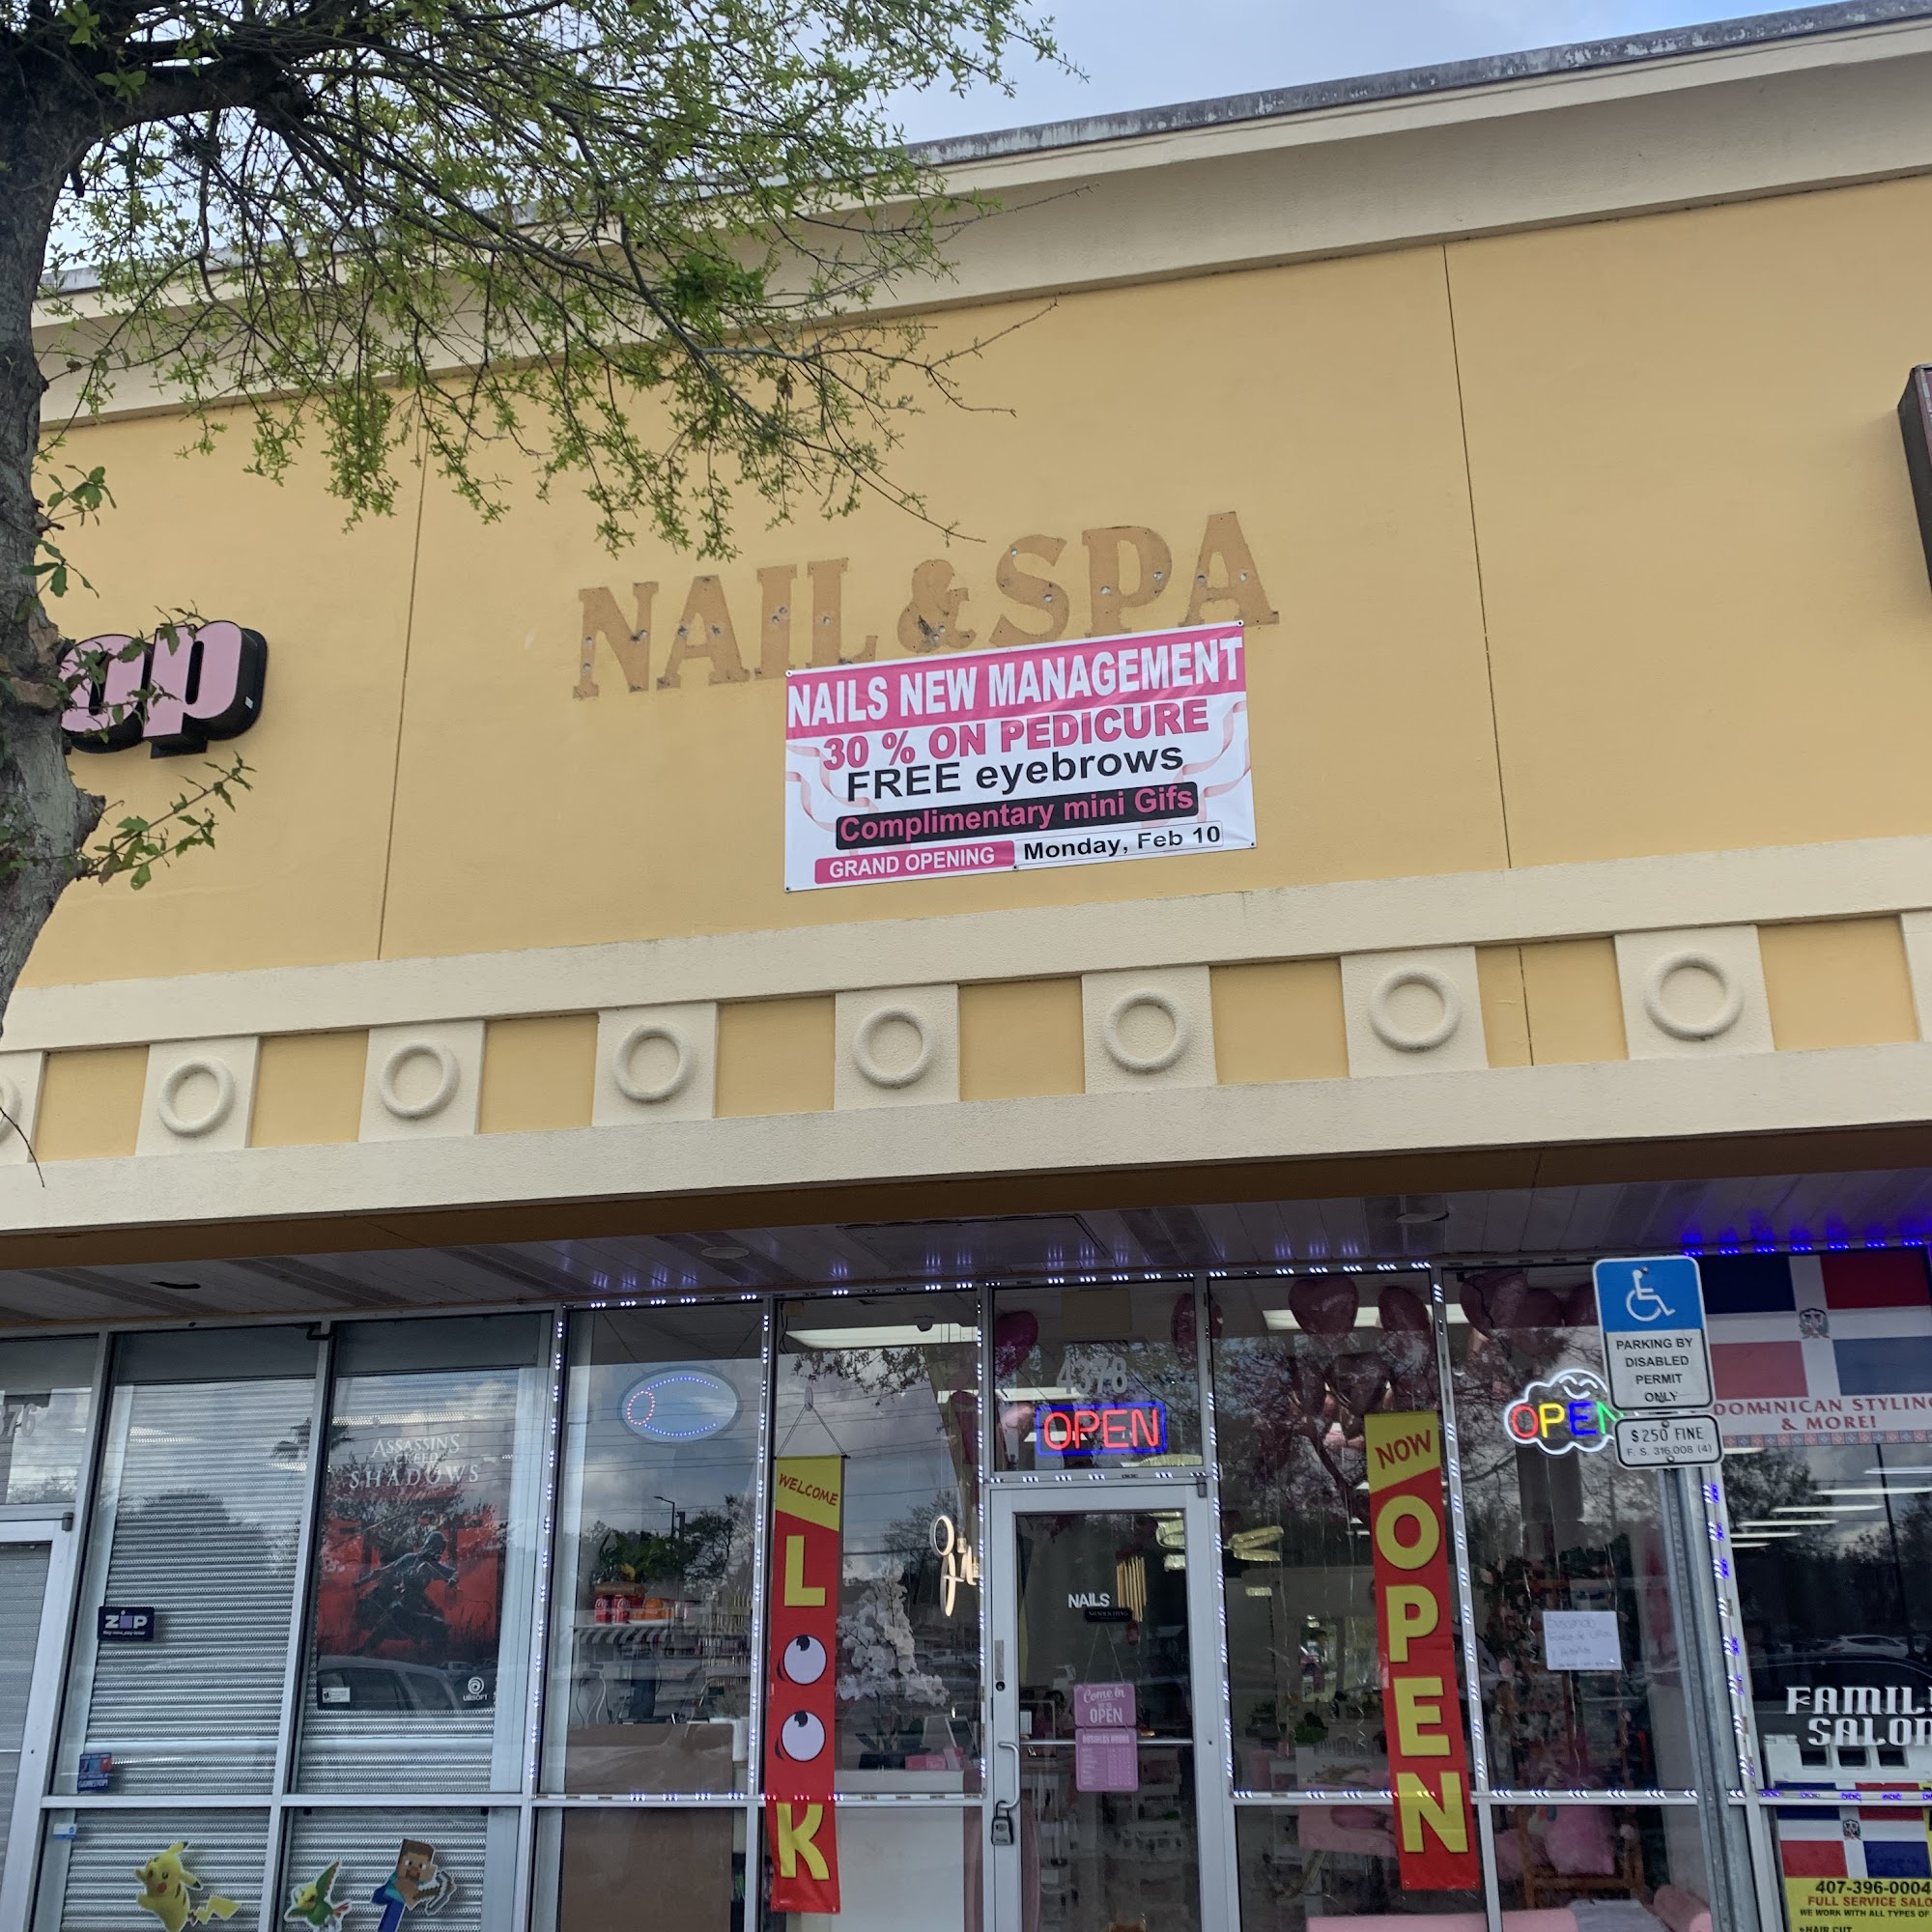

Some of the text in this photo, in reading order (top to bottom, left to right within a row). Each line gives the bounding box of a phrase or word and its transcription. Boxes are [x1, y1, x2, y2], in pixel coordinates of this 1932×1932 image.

[573, 511, 1279, 698] NAIL & SPA
[788, 637, 1243, 728] NAILS NEW MANAGEMENT
[823, 698, 1209, 770] 30 % ON PEDICURE
[848, 747, 1183, 802] FREE eyebrows
[840, 783, 1194, 842] Complimentary mini Gifs
[1024, 826, 1221, 860] Monday, Feb 10
[829, 846, 995, 878] GRAND OPENING
[1616, 1337, 1694, 1350] PARKING BY
[1626, 1355, 1690, 1368] DISABLED
[1056, 1356, 1128, 1394] 4378
[1635, 1374, 1683, 1385] PERMIT
[1645, 1390, 1678, 1403] ONLY
[1713, 1399, 1843, 1416] DOMINICAN
[1043, 1407, 1159, 1450] OPEN
[1781, 1415, 1877, 1431] & MORE!
[1676, 1427, 1704, 1440] FINE
[1375, 1430, 1433, 1469] NOW
[1654, 1445, 1693, 1456] 316.008
[1698, 1443, 1713, 1454] (4)
[394, 1452, 440, 1465] CREED
[349, 1464, 479, 1489] SHADOWS
[779, 1472, 839, 1507] WELCOME
[1067, 1592, 1111, 1608] NAILS
[1376, 1494, 1468, 1854] OPEN
[1083, 1687, 1126, 1703] Come in
[1785, 1686, 1932, 1715] FAMIL
[1090, 1707, 1123, 1723] OPEN
[1815, 1880, 1932, 1895] 407-396-0004
[1807, 1895, 1838, 1907] FULL
[1843, 1896, 1896, 1908] SERVICE
[1844, 1909, 1867, 1918] WITH
[1889, 1910, 1916, 1918] TYPES
[1918, 1910, 1930, 1918] OF
